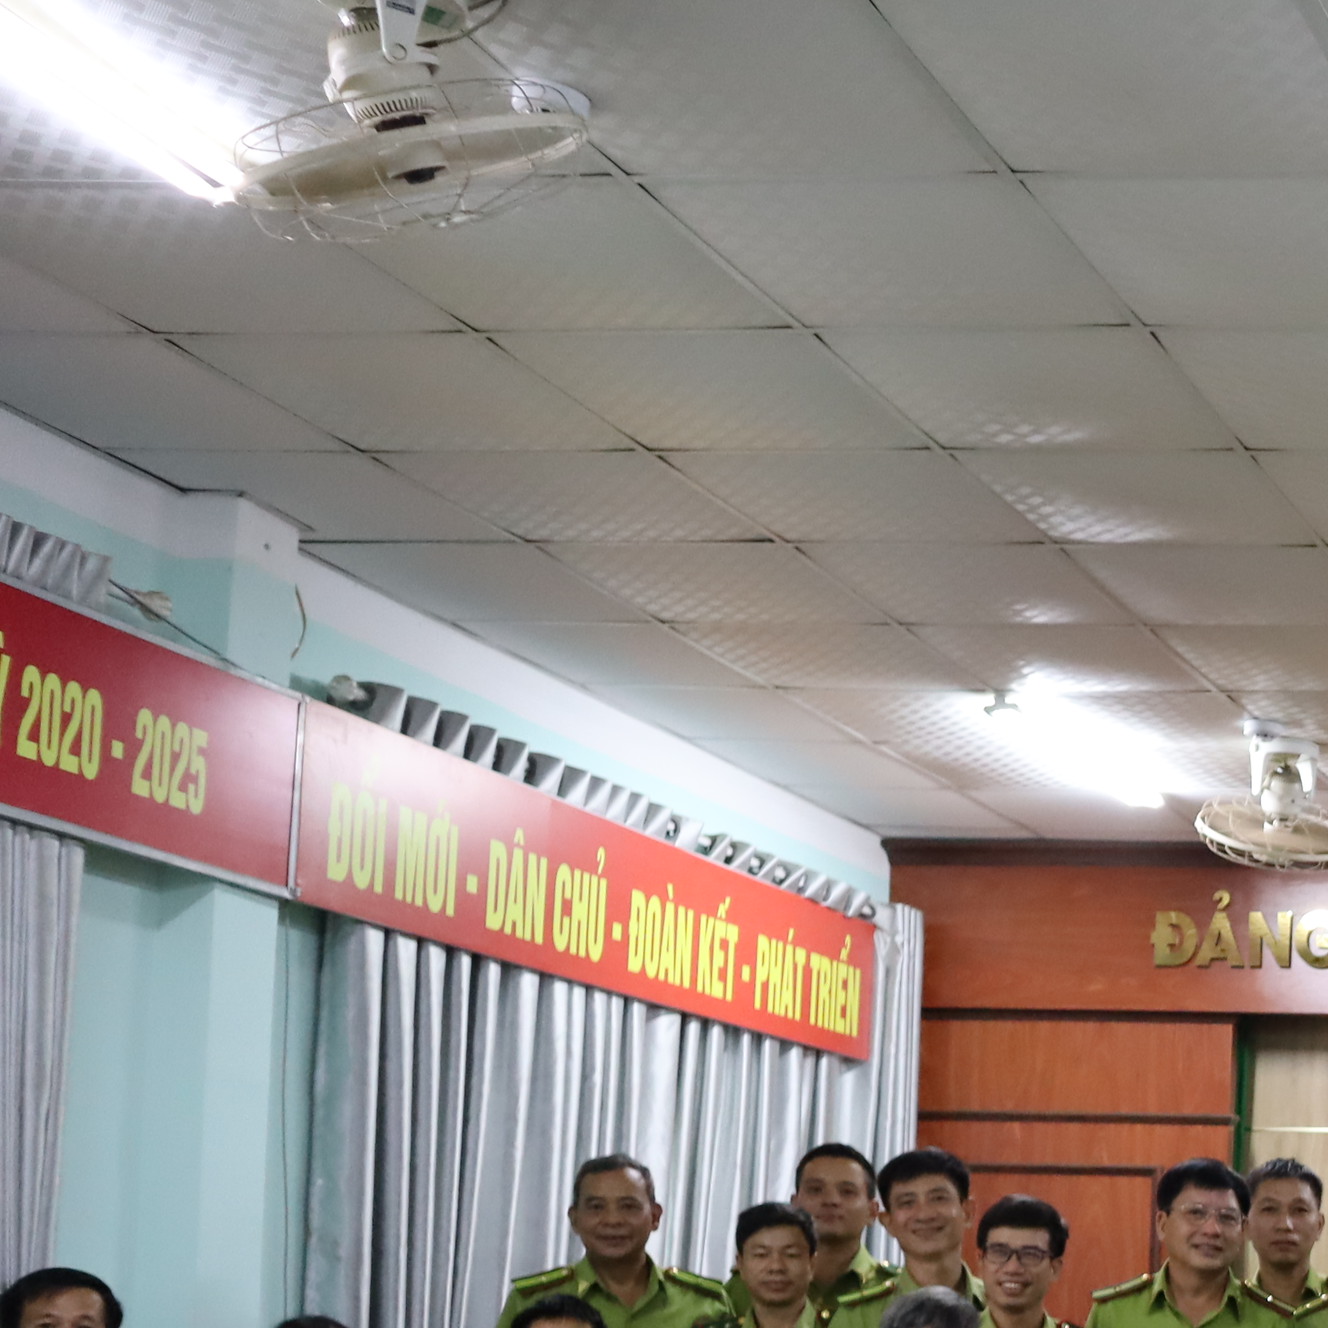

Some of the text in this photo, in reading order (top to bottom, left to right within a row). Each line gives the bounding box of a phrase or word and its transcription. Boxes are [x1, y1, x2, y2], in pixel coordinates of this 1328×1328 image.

[16, 664, 103, 780] 2020
[131, 708, 208, 816] 2025
[395, 801, 459, 918] MỚI
[485, 827, 548, 945] DÂN
[553, 846, 607, 963] CHỦ
[627, 883, 694, 990] ĐOÀN
[697, 896, 739, 1002] KẾT
[754, 928, 806, 1021] PHÁT
[810, 934, 861, 1038] TRIỂN
